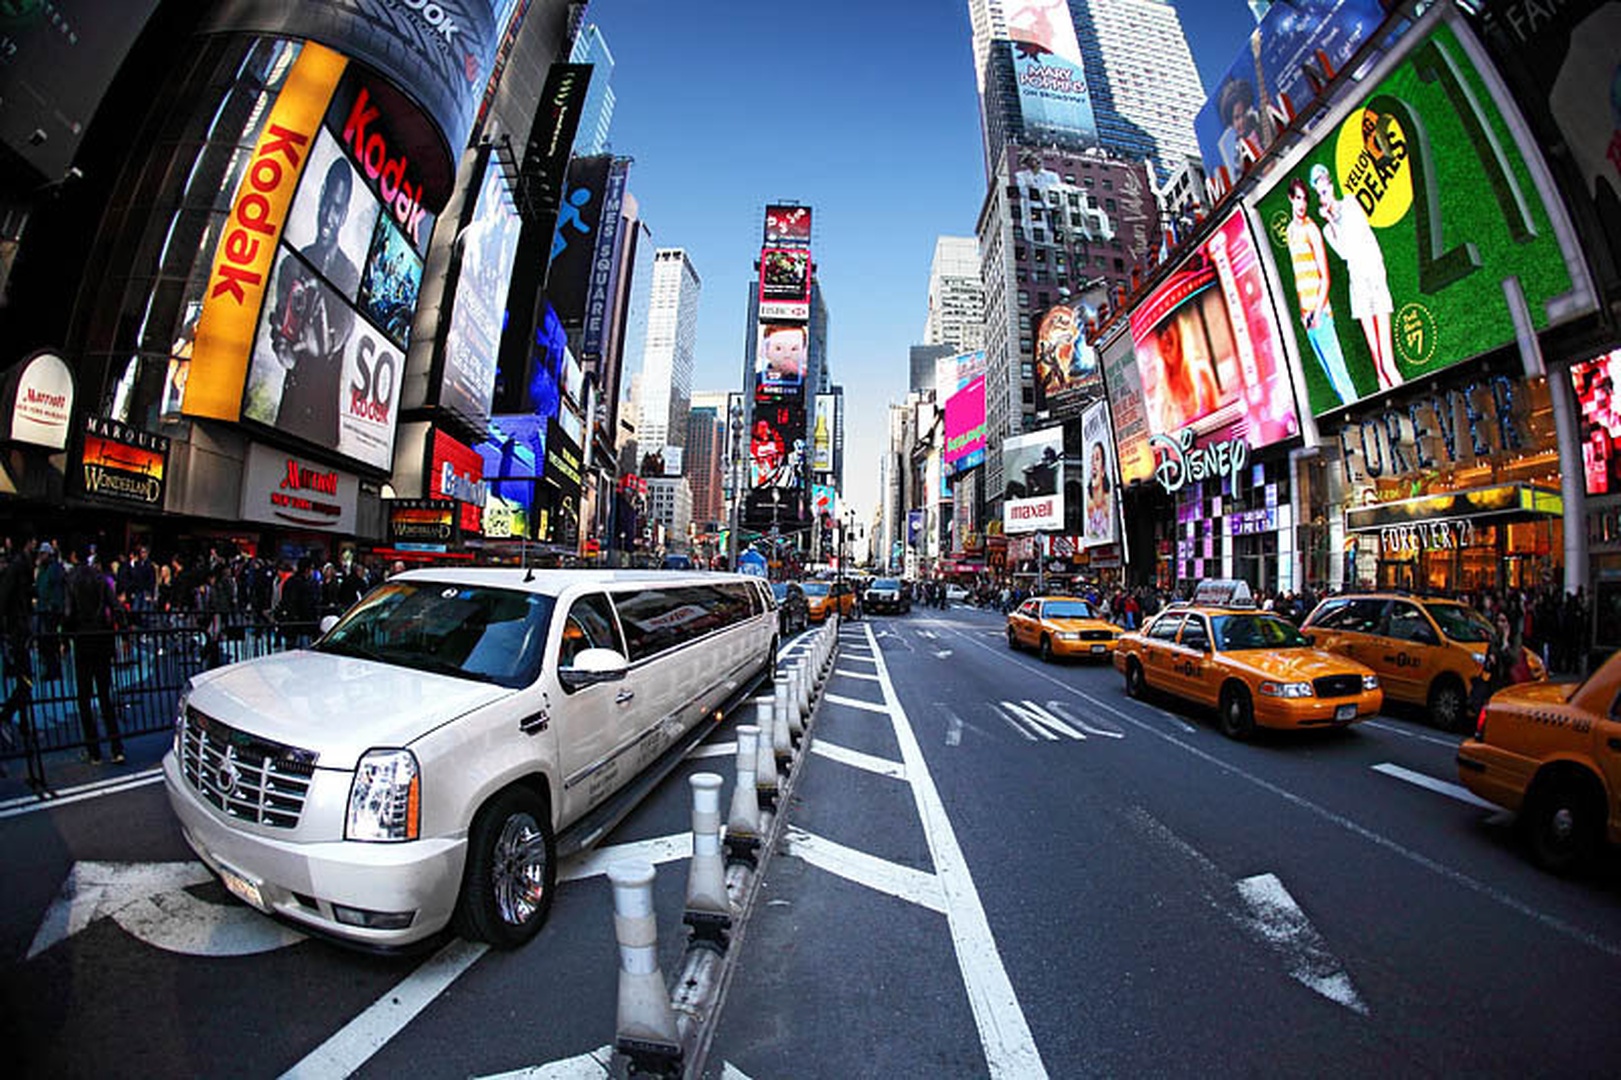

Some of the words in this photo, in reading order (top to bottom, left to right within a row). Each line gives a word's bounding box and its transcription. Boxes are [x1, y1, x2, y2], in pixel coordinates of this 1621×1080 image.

[1027, 64, 1073, 80] MARY
[343, 87, 426, 245] Kodak
[1355, 131, 1408, 218] DEALS
[211, 124, 309, 306] Kodak
[603, 175, 624, 237] TIMES
[589, 245, 611, 331] SQUARE
[351, 335, 395, 406] SO
[87, 417, 168, 450] MARQUIS
[350, 389, 389, 425] Kodak
[1010, 500, 1053, 520] maxell
[1381, 521, 1453, 552] FOREVER
[1456, 519, 1475, 547] 21
